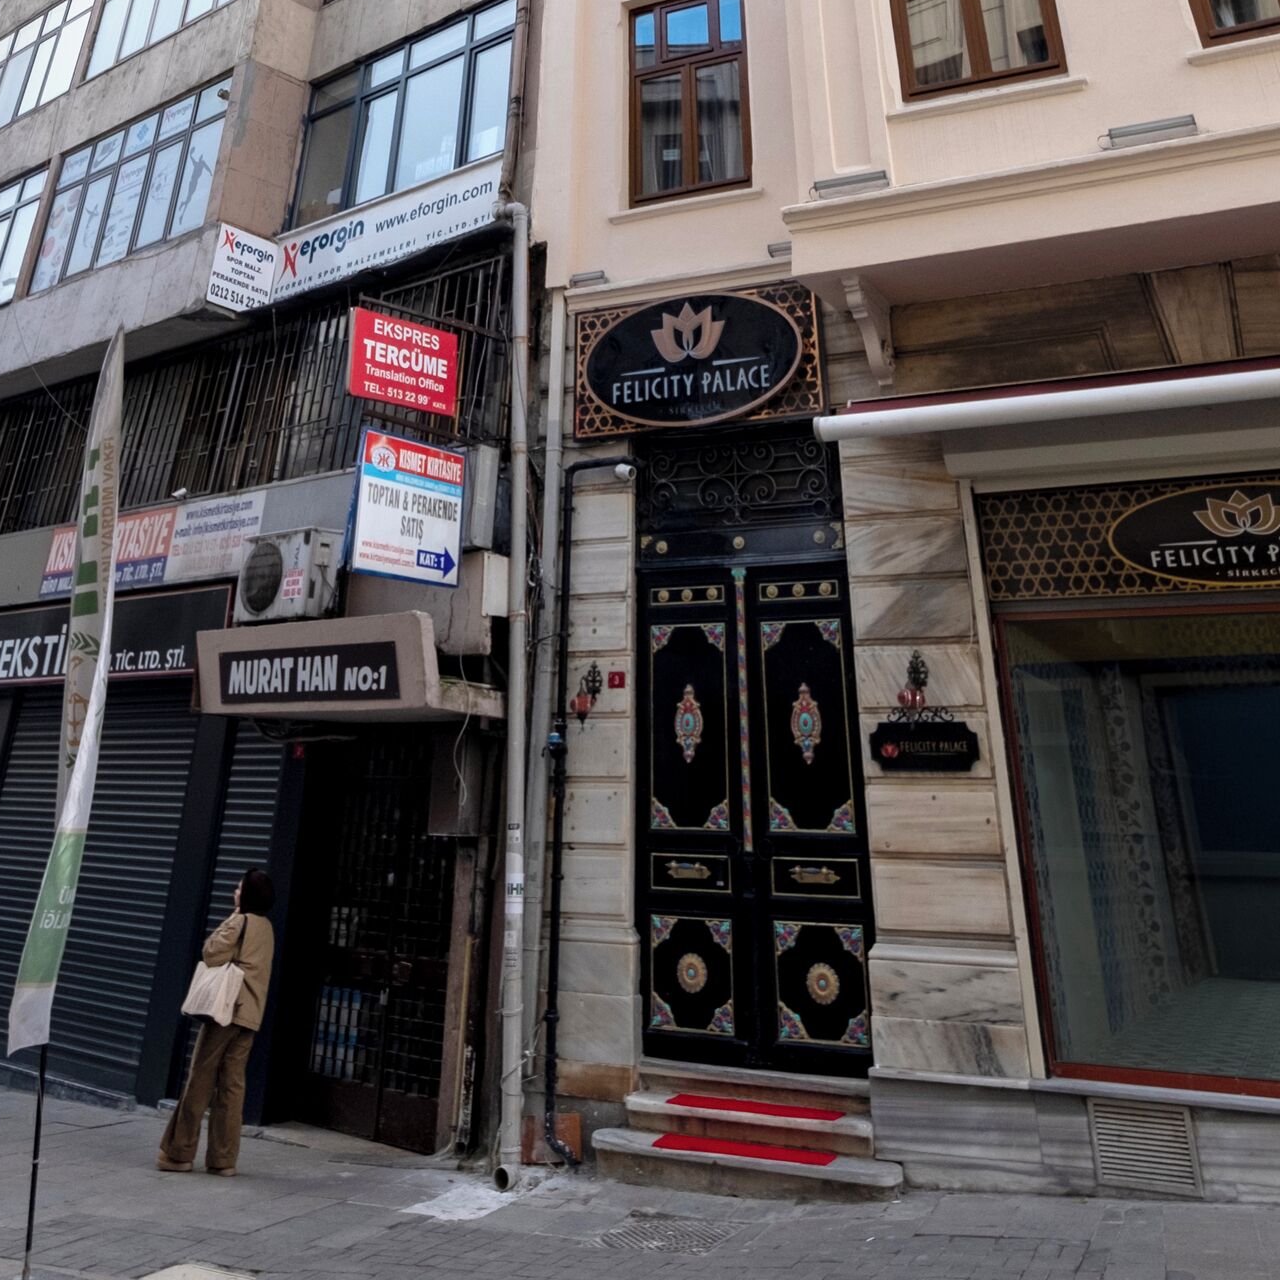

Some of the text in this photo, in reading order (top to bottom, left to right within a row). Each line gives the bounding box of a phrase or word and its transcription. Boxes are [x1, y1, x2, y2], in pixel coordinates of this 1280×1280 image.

[375, 180, 493, 234] www.eforgin.com
[226, 255, 243, 267] SPOR
[231, 267, 255, 281] TOPTAN
[317, 265, 342, 280] SPOR
[212, 270, 250, 289] PERAKENDE
[210, 283, 229, 300] 0212
[230, 291, 244, 305] 514
[373, 318, 440, 351] EKSPRES
[363, 338, 448, 379] TERCÜME
[365, 363, 445, 393] Translation Office
[612, 365, 770, 405] FELICITY PALACE
[363, 381, 385, 395] TEL:
[387, 387, 403, 400] 513
[405, 391, 416, 403] 22
[399, 449, 462, 482] KISMET KIRTASİYE
[368, 482, 400, 509] TOPTAN
[402, 492, 409, 511] &
[411, 493, 458, 522] PERAKENDE
[400, 516, 424, 545] SATIŞ
[419, 552, 445, 569] KAT: 1
[1150, 545, 1256, 568] FELICITY
[115, 648, 136, 671] TİC.
[138, 649, 161, 669] LTD.
[164, 645, 186, 671] ŞTİ.
[228, 654, 388, 695] MURAT HAN NO:1
[900, 740, 968, 752] FELICITY PALACE
